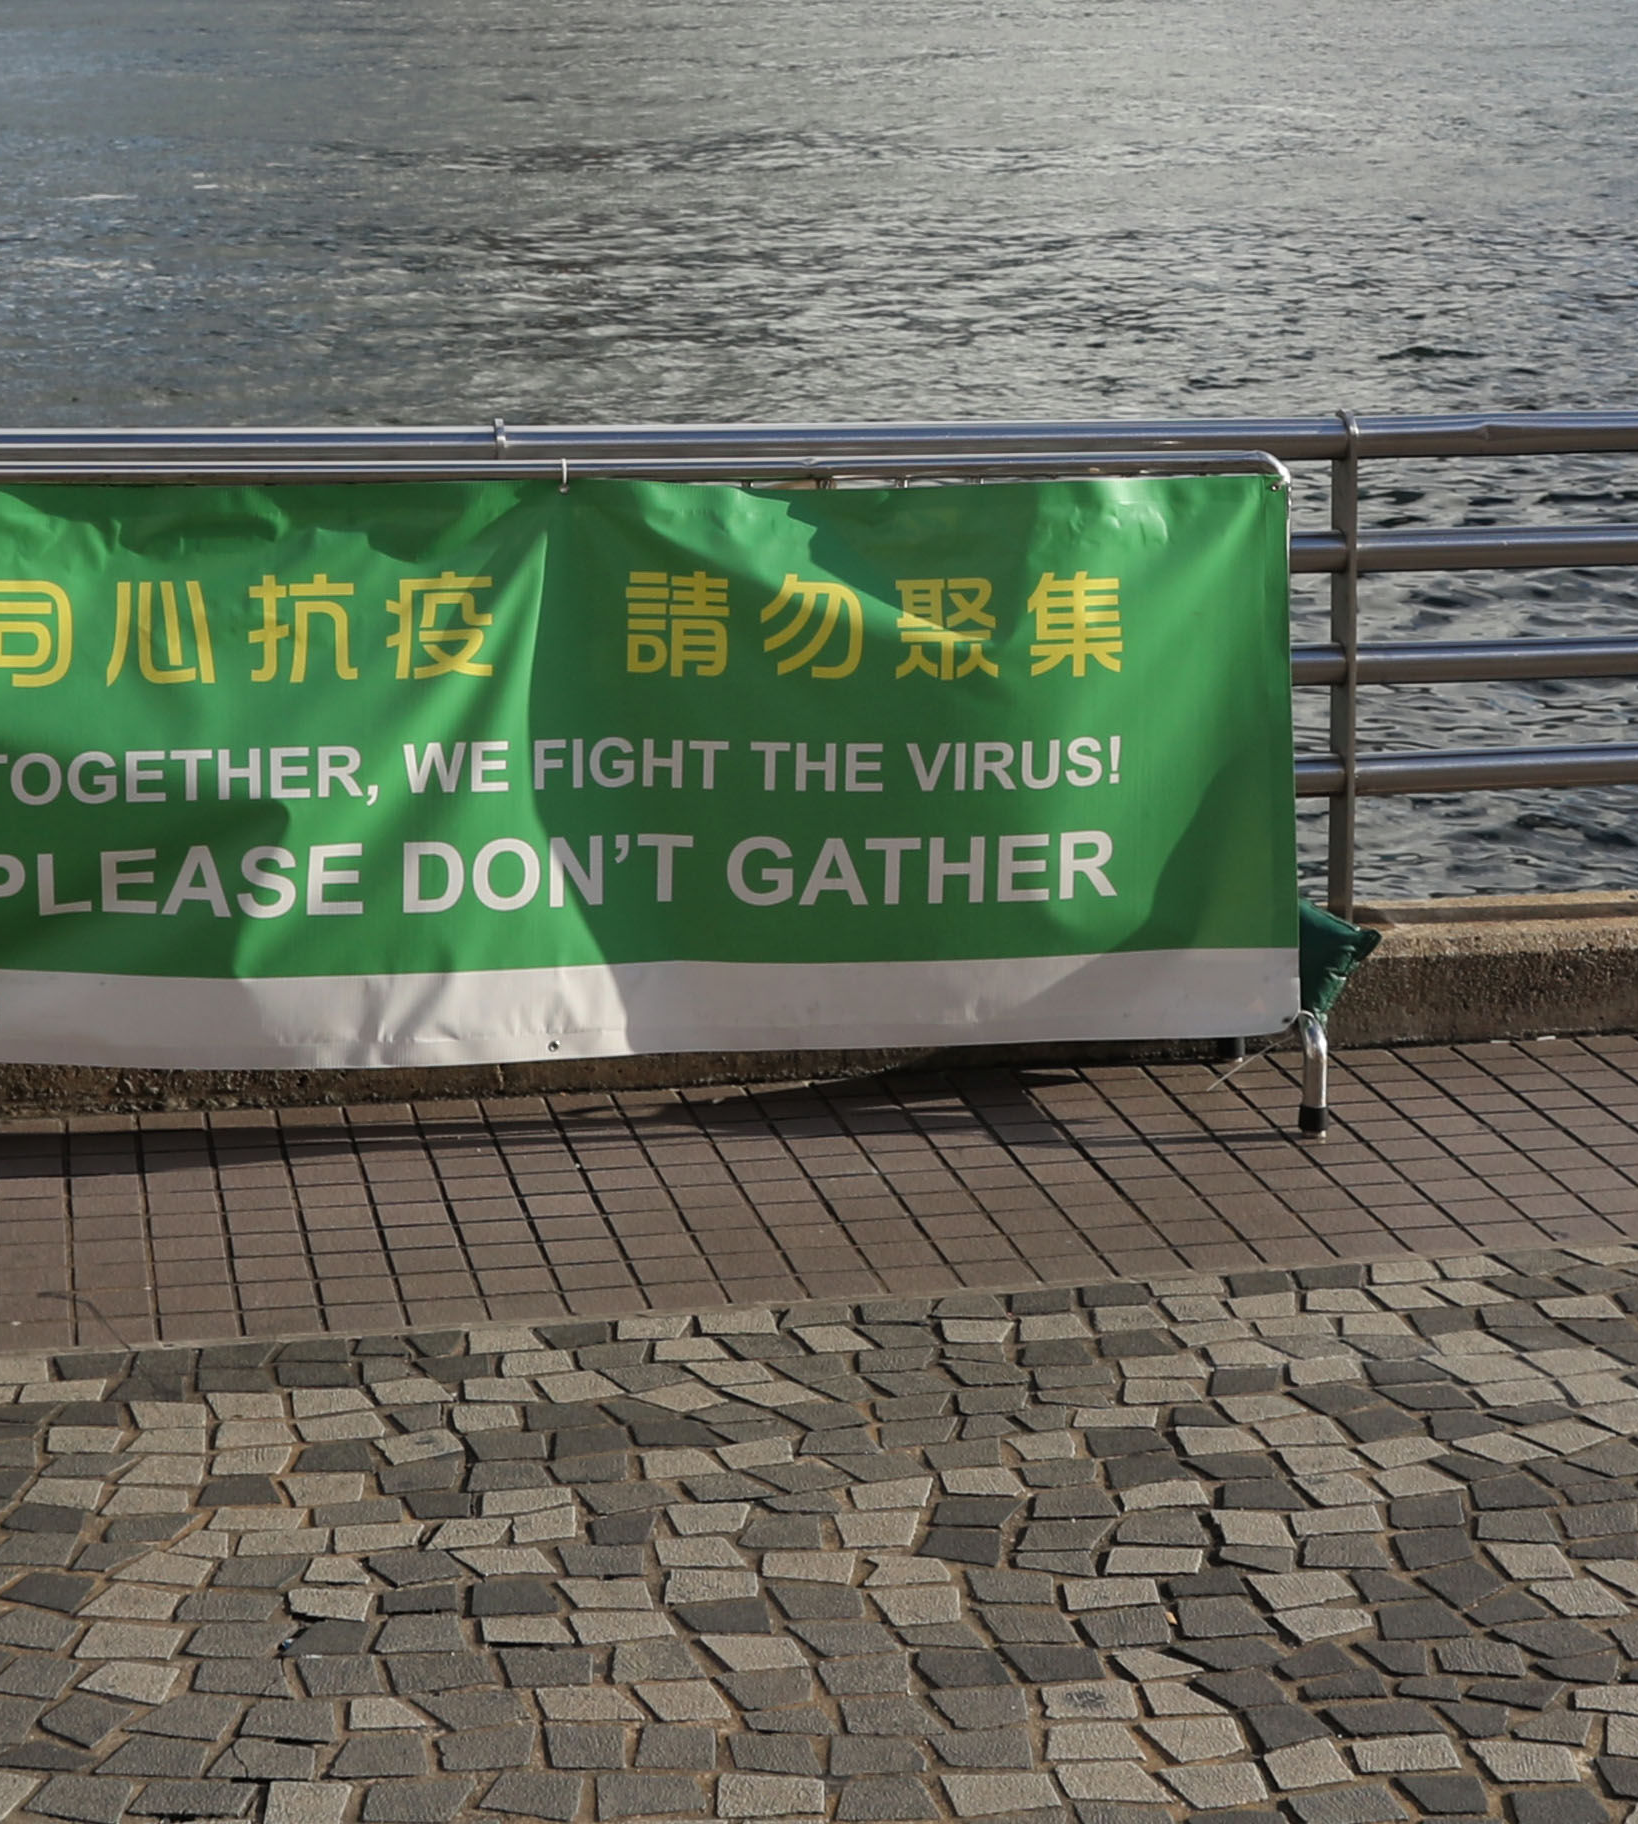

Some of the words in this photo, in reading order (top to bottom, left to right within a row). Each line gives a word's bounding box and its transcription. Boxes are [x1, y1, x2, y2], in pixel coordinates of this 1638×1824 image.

[625, 571, 1124, 680] 請勿聚集
[402, 739, 511, 795] WE
[533, 736, 729, 791] FIGHT
[750, 741, 883, 792] THE
[906, 735, 1123, 791] VIRUS!
[402, 833, 694, 915] DON’T
[726, 829, 1119, 906] GATHER
